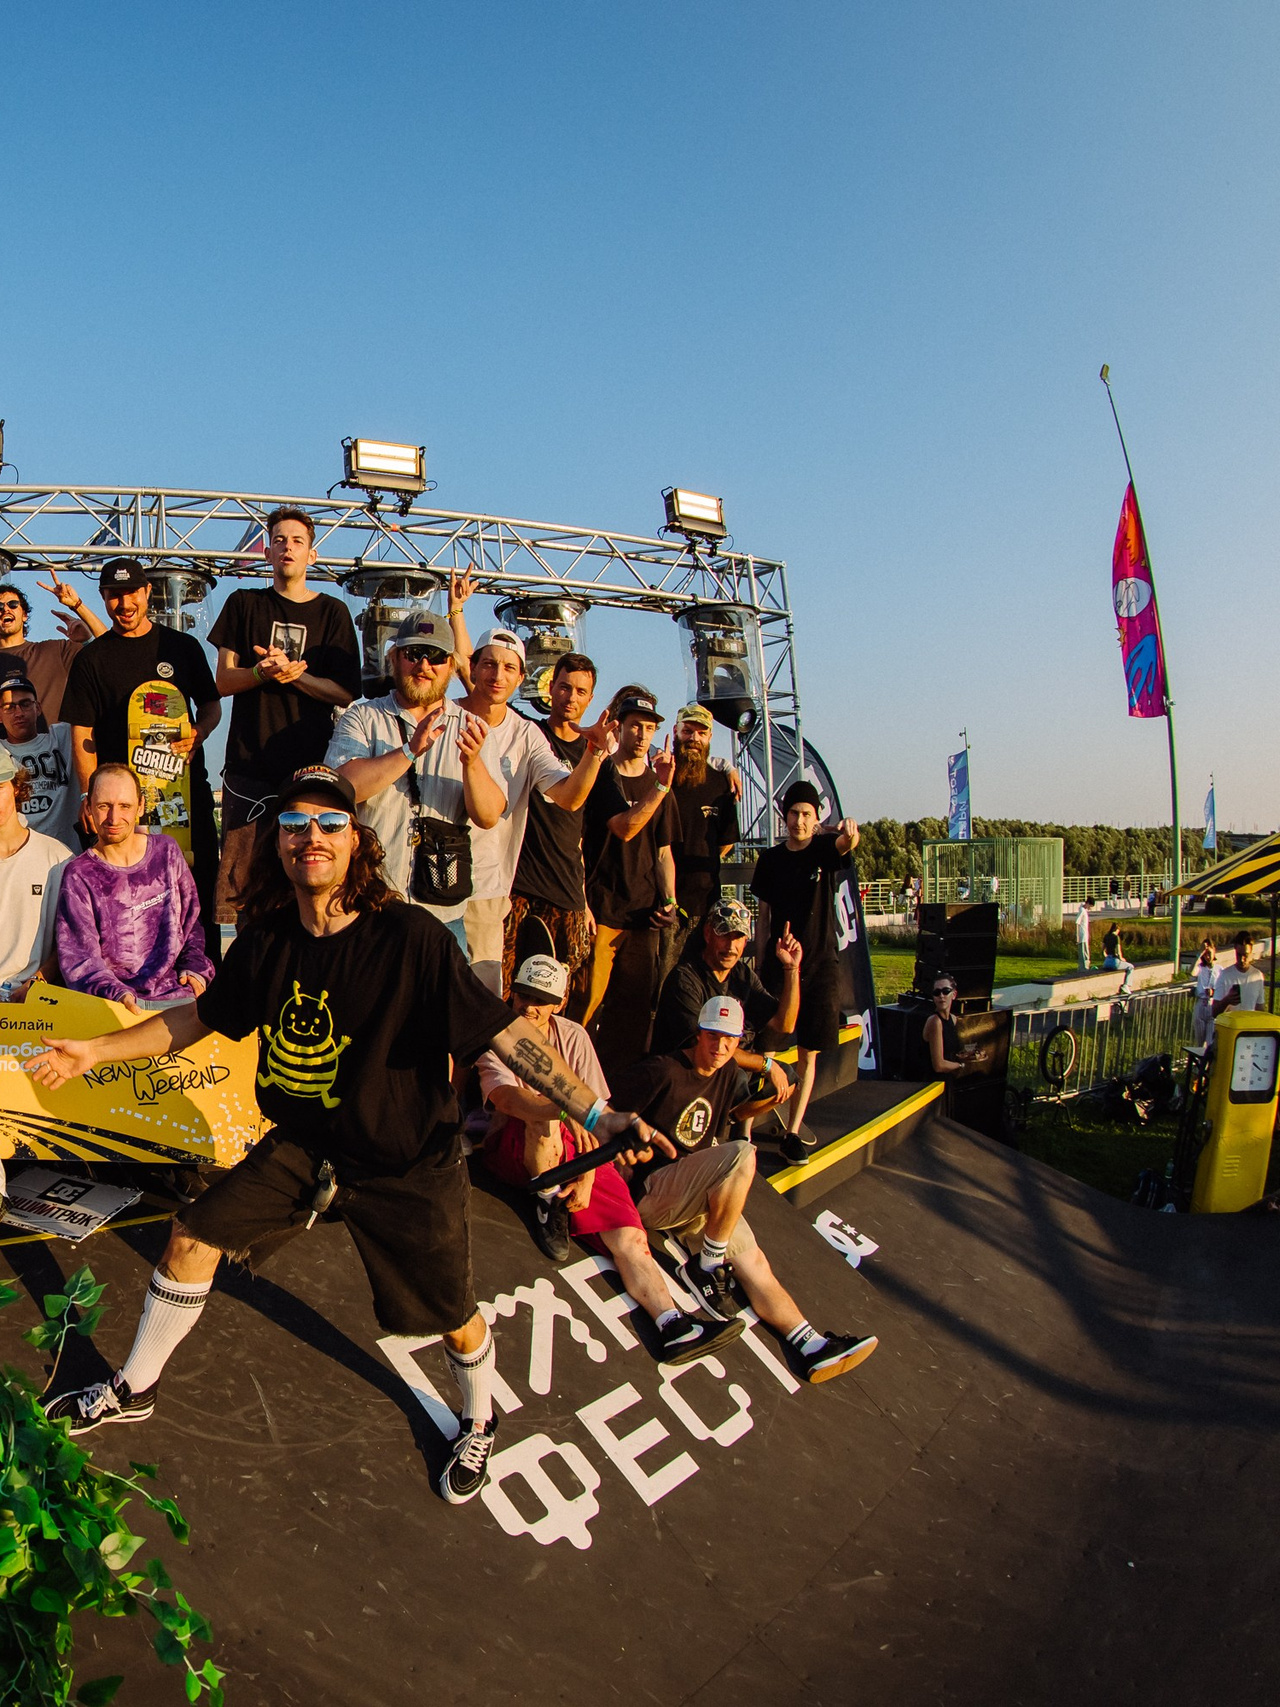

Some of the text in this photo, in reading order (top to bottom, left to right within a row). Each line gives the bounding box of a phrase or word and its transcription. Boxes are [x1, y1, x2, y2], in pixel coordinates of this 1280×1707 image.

[133, 747, 184, 774] GORILLA
[293, 765, 331, 781] HARLEY
[0, 1017, 53, 1031] билайн
